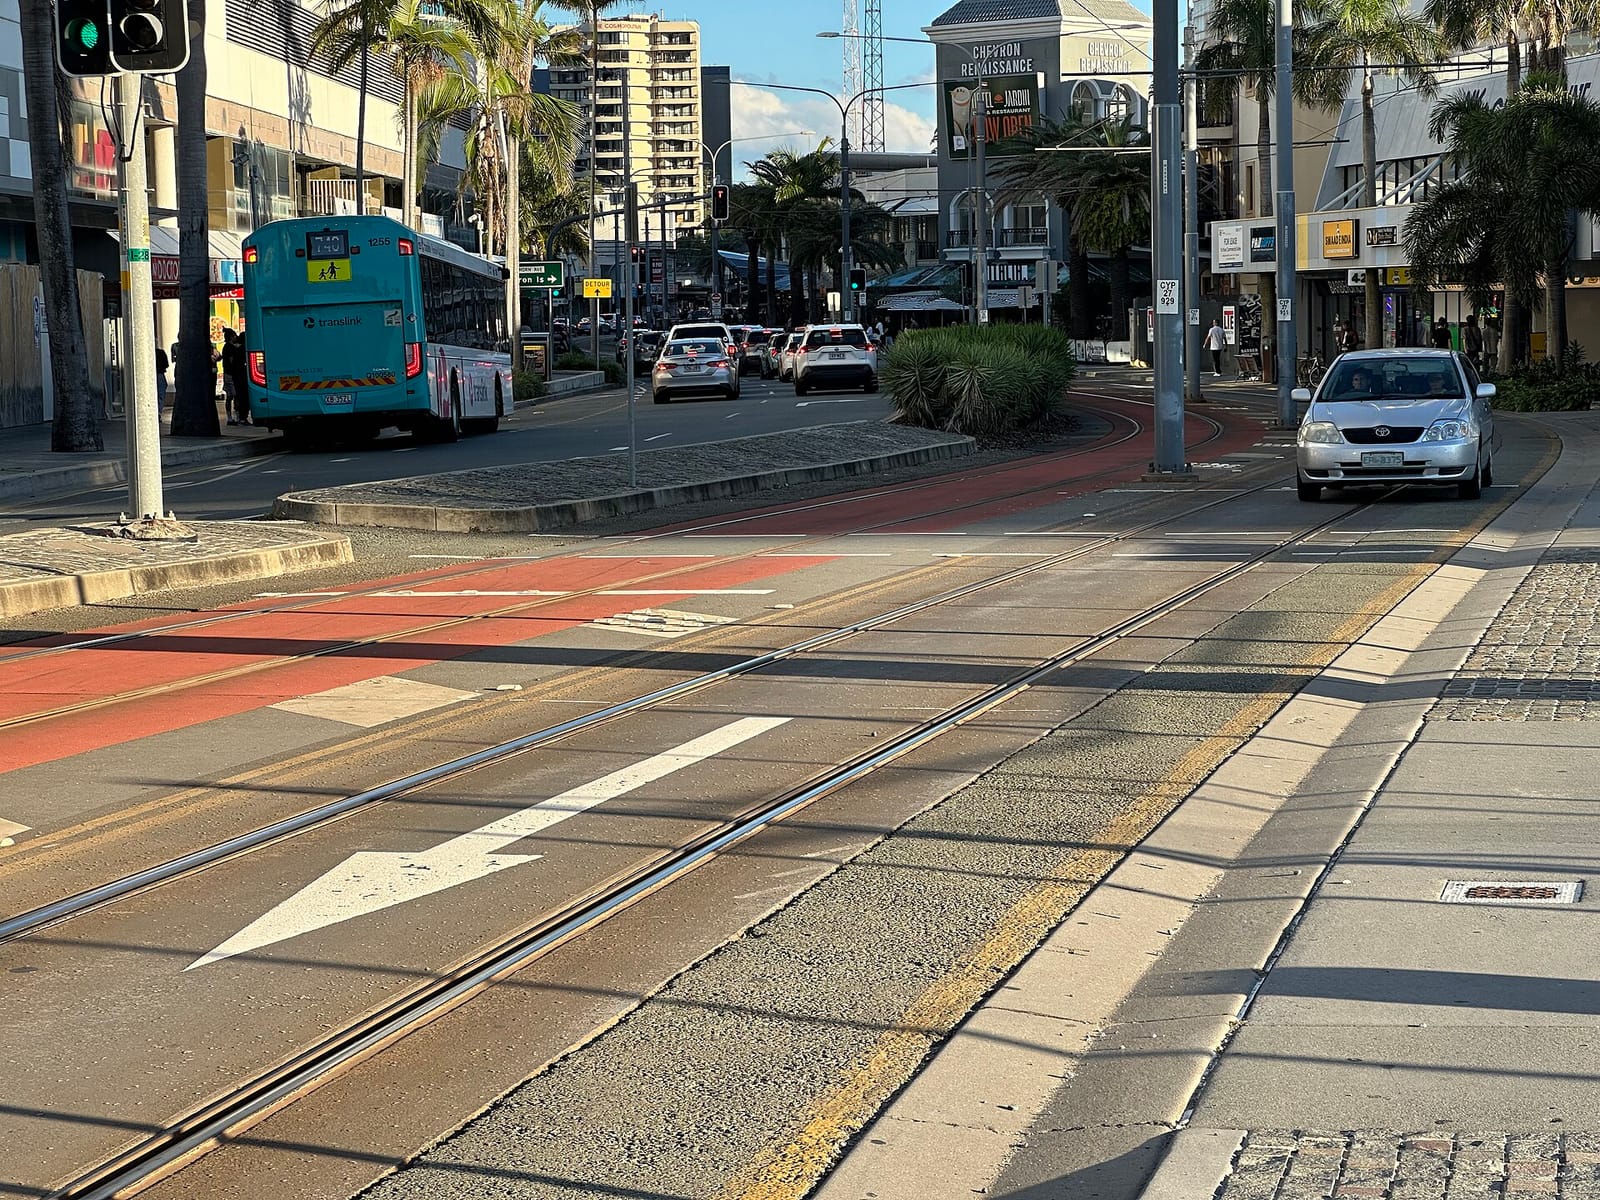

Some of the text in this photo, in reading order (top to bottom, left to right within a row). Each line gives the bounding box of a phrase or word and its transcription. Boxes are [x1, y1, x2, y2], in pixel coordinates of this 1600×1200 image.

[973, 42, 1021, 60] CHEVRON
[1088, 42, 1124, 58] CHEVRON
[961, 58, 1033, 77] RENAISSANCE
[1080, 57, 1132, 73] RENAISSANCE
[992, 107, 1031, 115] RESTAURANT
[315, 236, 340, 252] 740
[368, 237, 391, 247] 1255
[1160, 281, 1176, 289] CYP
[1163, 289, 1172, 297] 27
[1160, 297, 1175, 305] 929
[318, 315, 363, 328] translink
